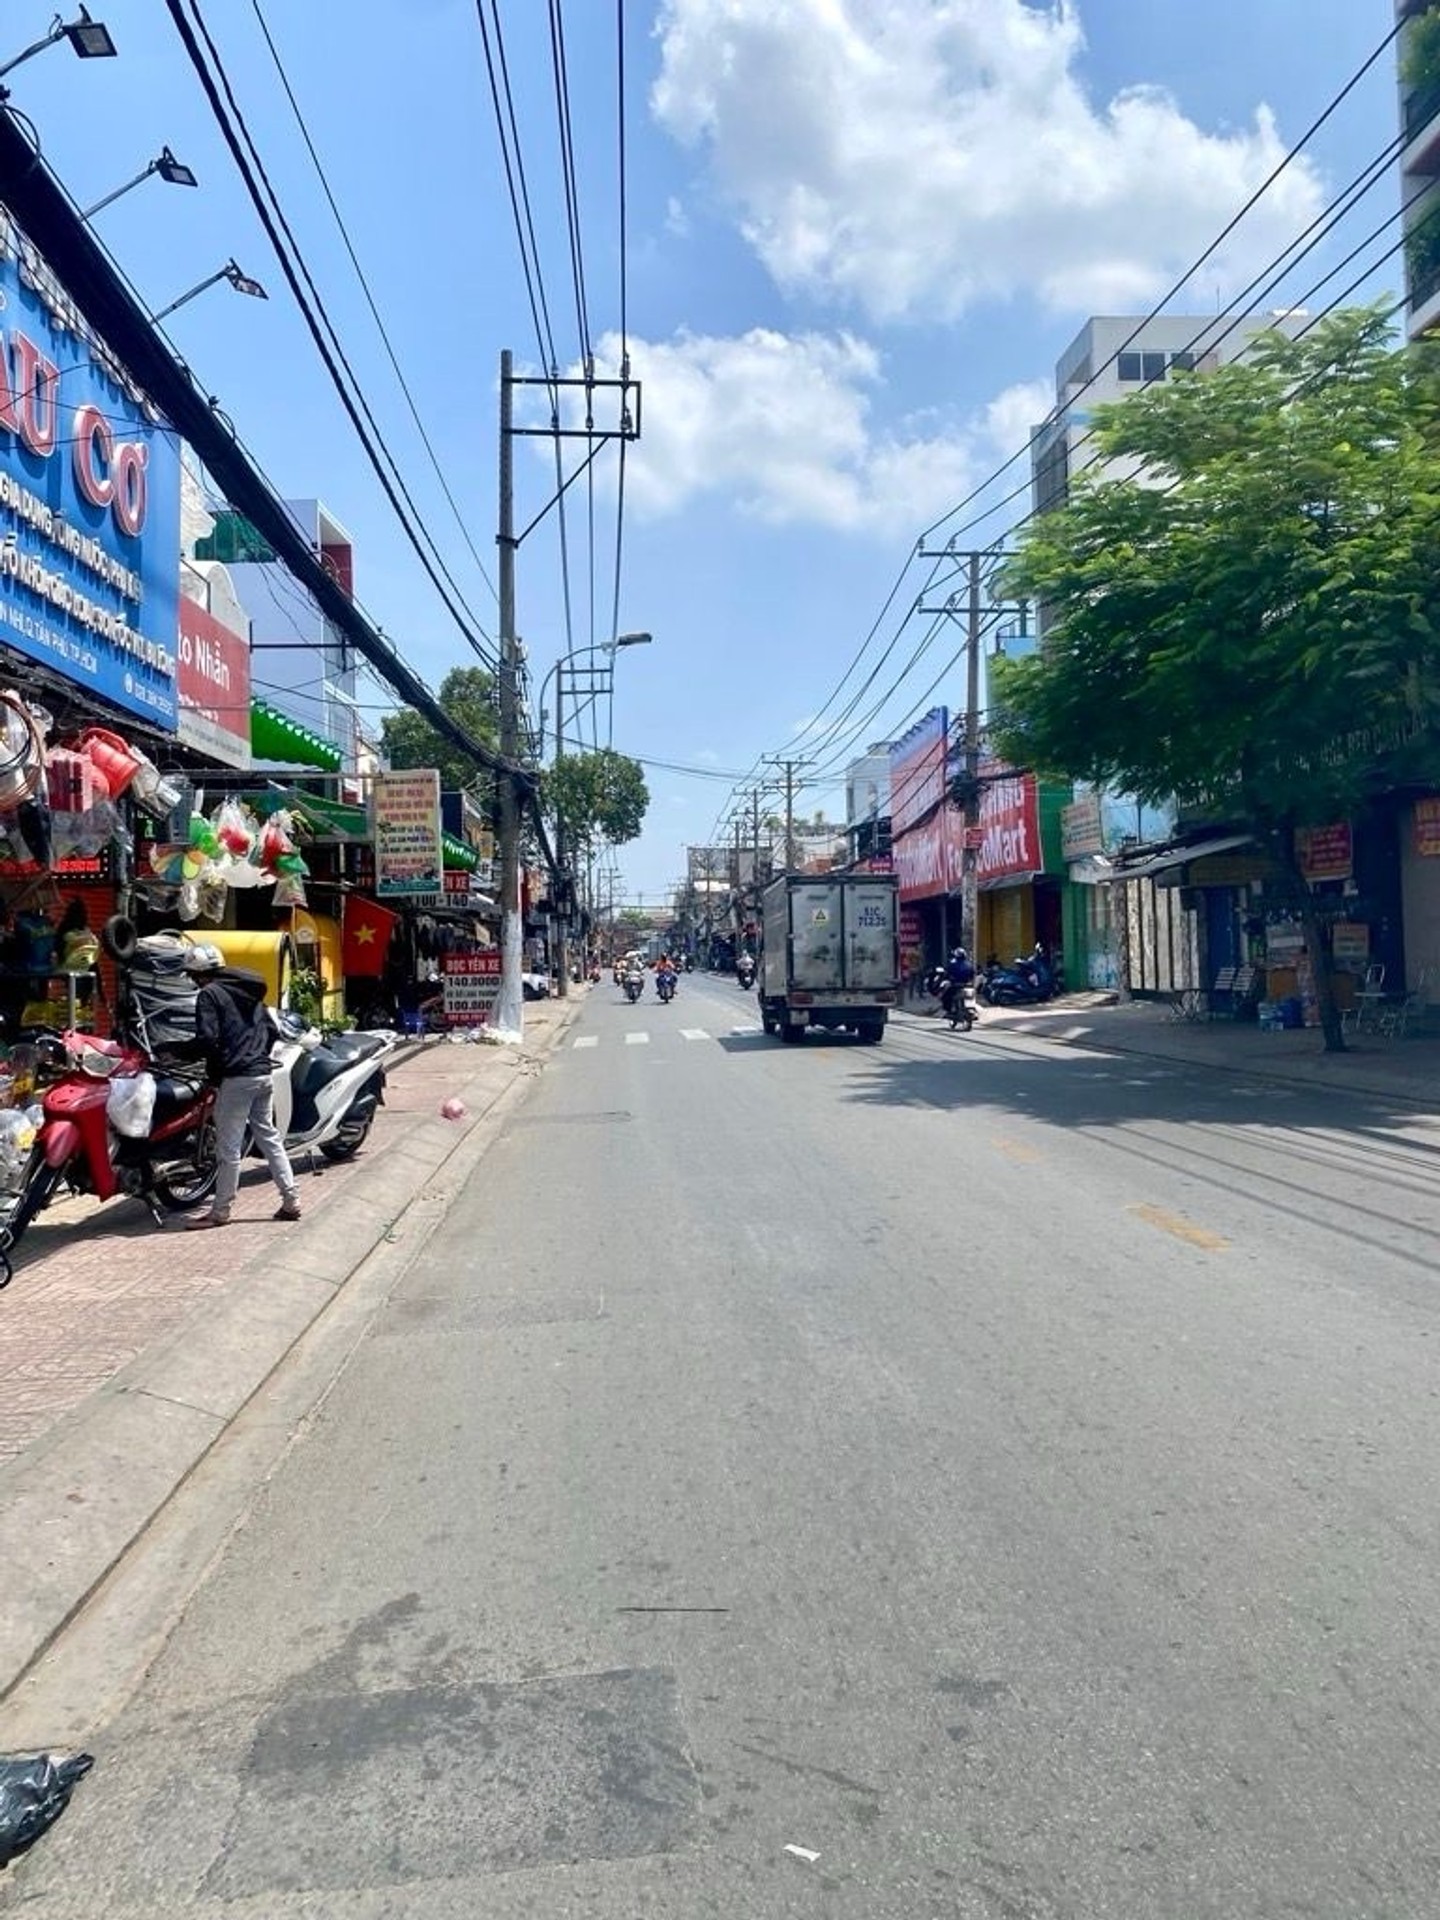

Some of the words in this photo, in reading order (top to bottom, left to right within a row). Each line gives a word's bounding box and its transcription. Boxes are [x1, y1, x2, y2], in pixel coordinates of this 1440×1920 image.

[73, 404, 149, 537] CƠ
[177, 624, 192, 667] to
[487, 957, 500, 972] XE
